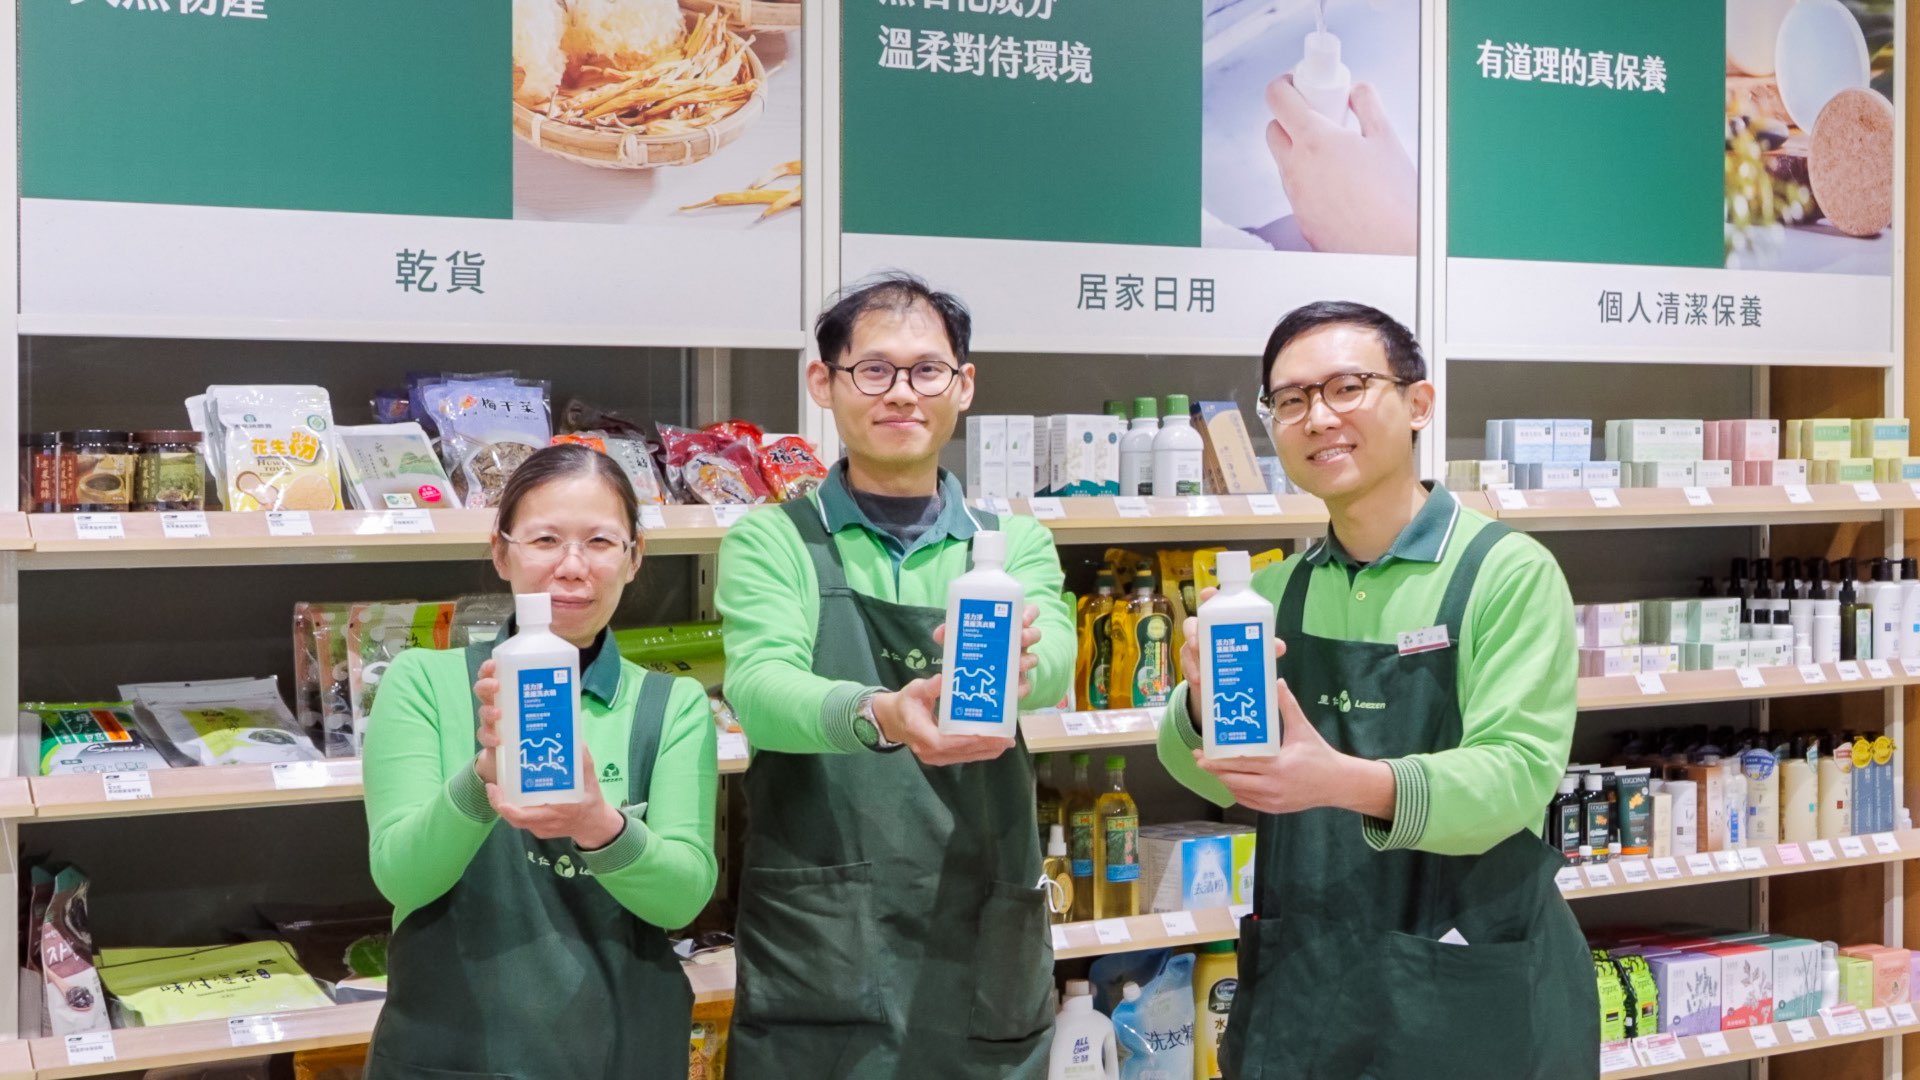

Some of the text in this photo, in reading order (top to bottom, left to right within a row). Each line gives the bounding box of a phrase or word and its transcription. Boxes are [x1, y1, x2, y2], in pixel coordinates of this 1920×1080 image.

[878, 25, 1093, 84] 溫柔對待環境
[1477, 39, 1667, 94] 有道理的真保養
[395, 248, 486, 295] 乾貨
[1077, 273, 1216, 313] 居家日用
[1597, 289, 1763, 328] 個人清潔保養
[481, 397, 535, 414] 梅干菜
[250, 431, 319, 462] 花生粉
[1354, 700, 1386, 710] Leezen
[1622, 777, 1648, 785] LOGONA
[160, 969, 256, 994] 味付海苔
[1073, 1046, 1090, 1055] Clean
[1074, 1037, 1089, 1046] ALL
